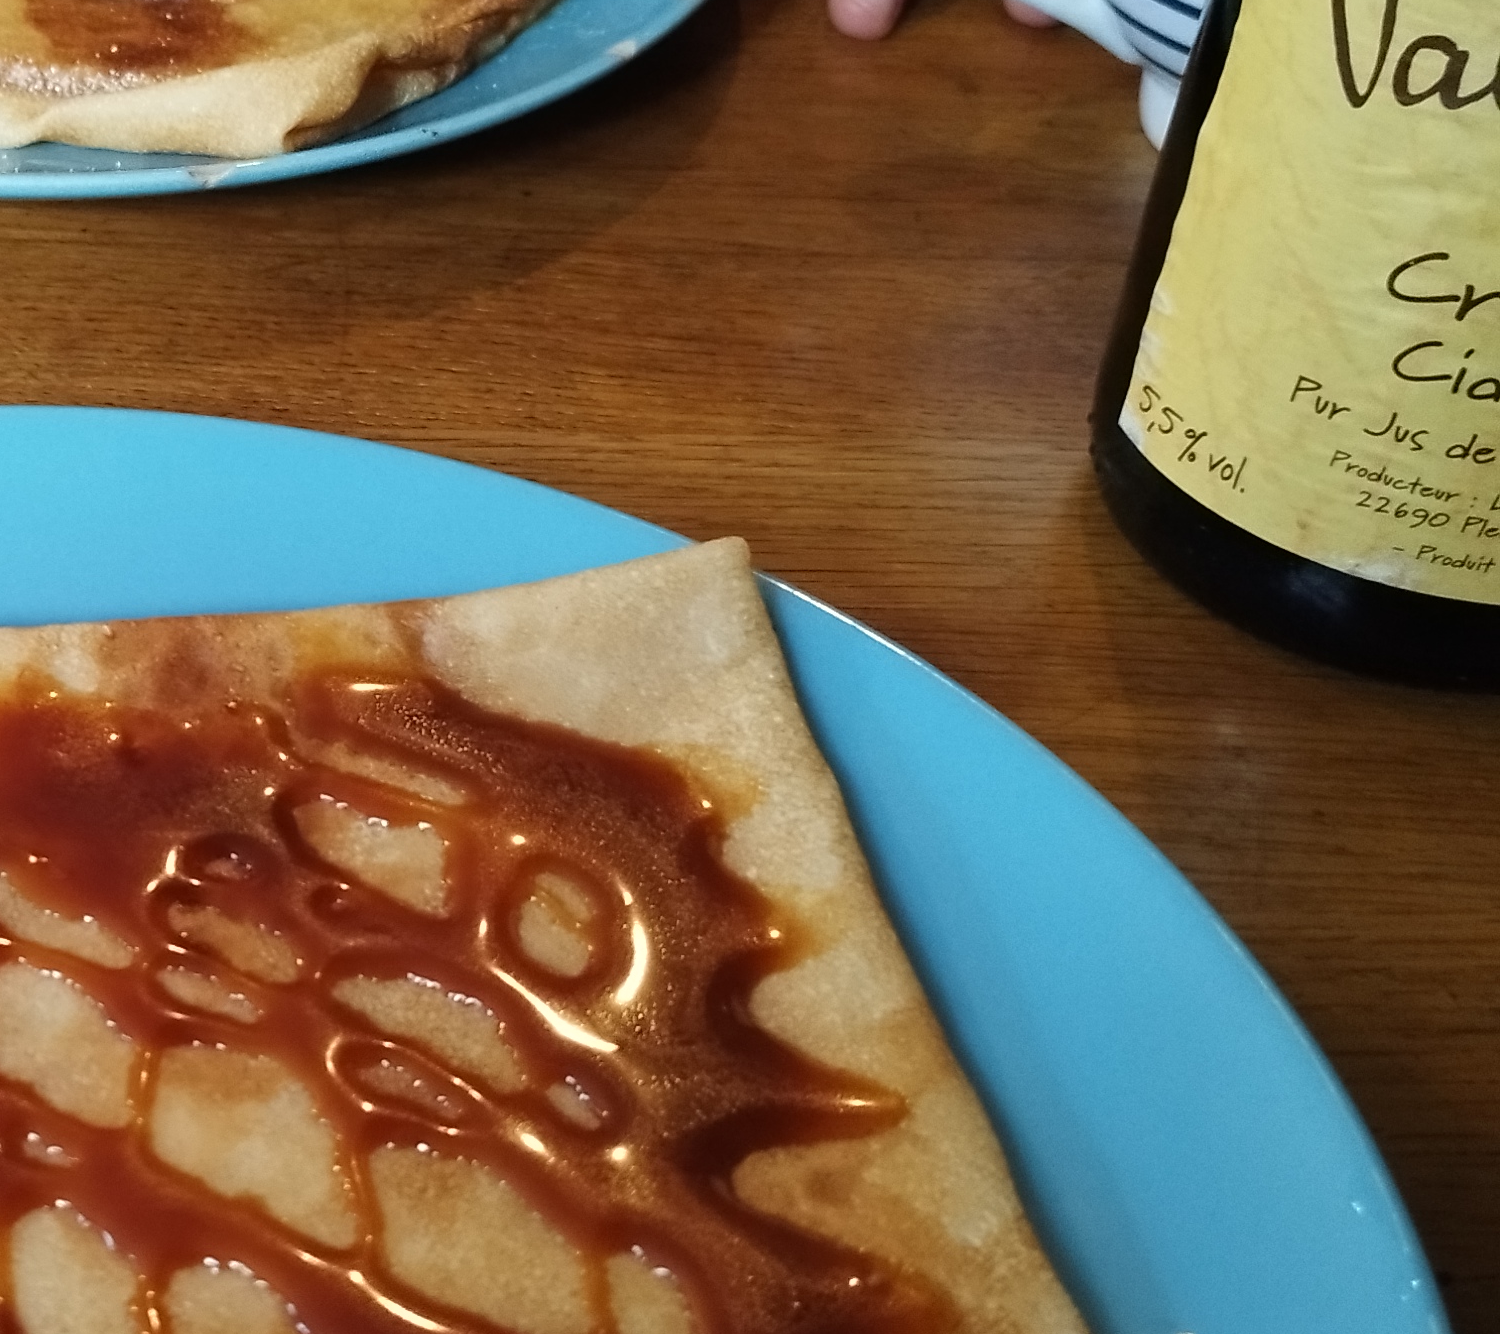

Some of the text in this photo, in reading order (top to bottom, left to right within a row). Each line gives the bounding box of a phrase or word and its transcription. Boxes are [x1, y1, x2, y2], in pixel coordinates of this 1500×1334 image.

[1289, 374, 1497, 465] Pur Jus de
[1208, 453, 1248, 494] vol.
[1355, 490, 1451, 529] 22690
[1415, 544, 1497, 574] Produit
